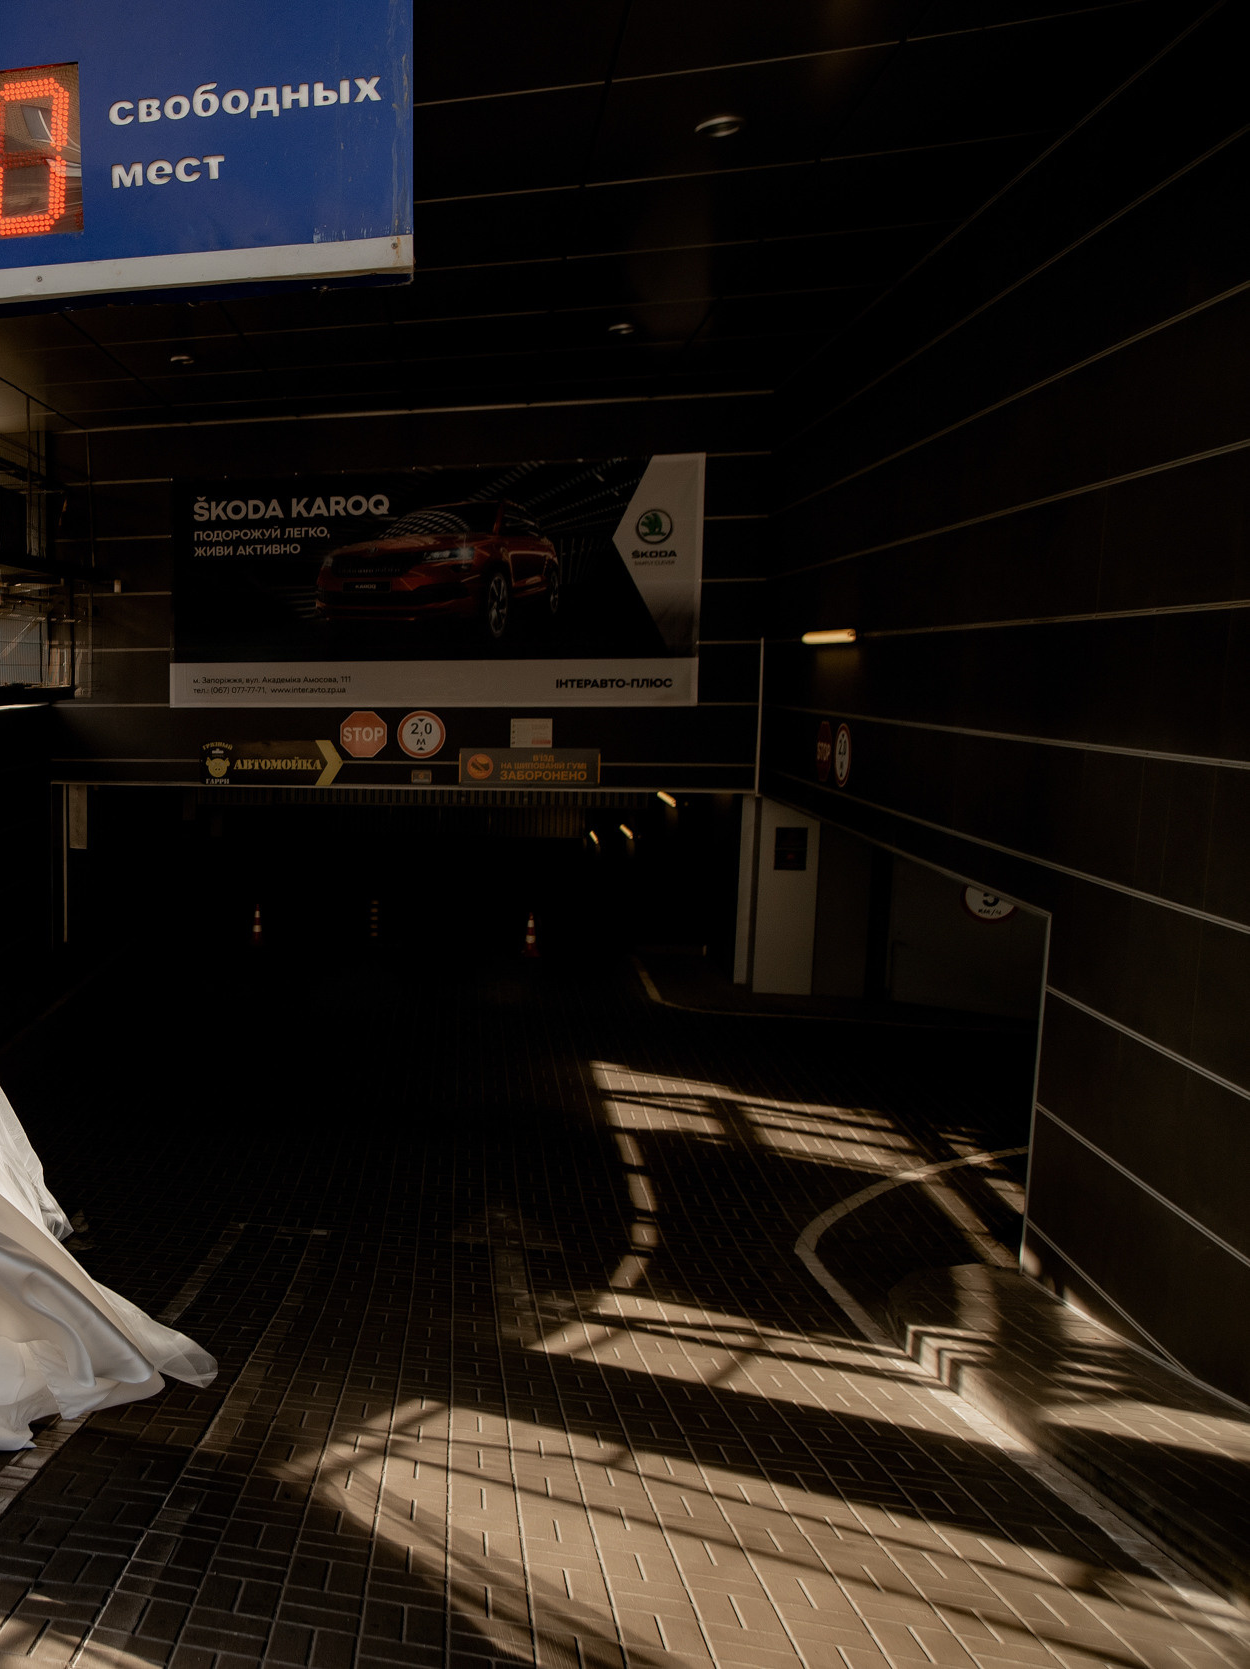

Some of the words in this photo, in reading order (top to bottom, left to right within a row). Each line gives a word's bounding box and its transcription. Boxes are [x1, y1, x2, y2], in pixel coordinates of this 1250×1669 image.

[109, 76, 381, 126] свободных
[111, 154, 225, 189] мест
[193, 496, 284, 522] ŠKODA
[291, 493, 390, 518] KAROQ
[194, 525, 281, 542] ПОДОРОЖУЙ
[284, 526, 331, 541] ЛЕГКО,
[194, 546, 233, 557] ЖИВИ
[236, 543, 301, 557] АКТИВНО
[262, 676, 301, 685] Академіка
[303, 676, 339, 684] Амосова,
[556, 678, 673, 689] ІНТЕРАВТО-ПЛЮС
[343, 727, 384, 742] STOP
[411, 722, 433, 736] 2,0
[233, 756, 323, 770] АВТОМОЙКА
[500, 770, 587, 781] ЗАБОРОНЕНО
